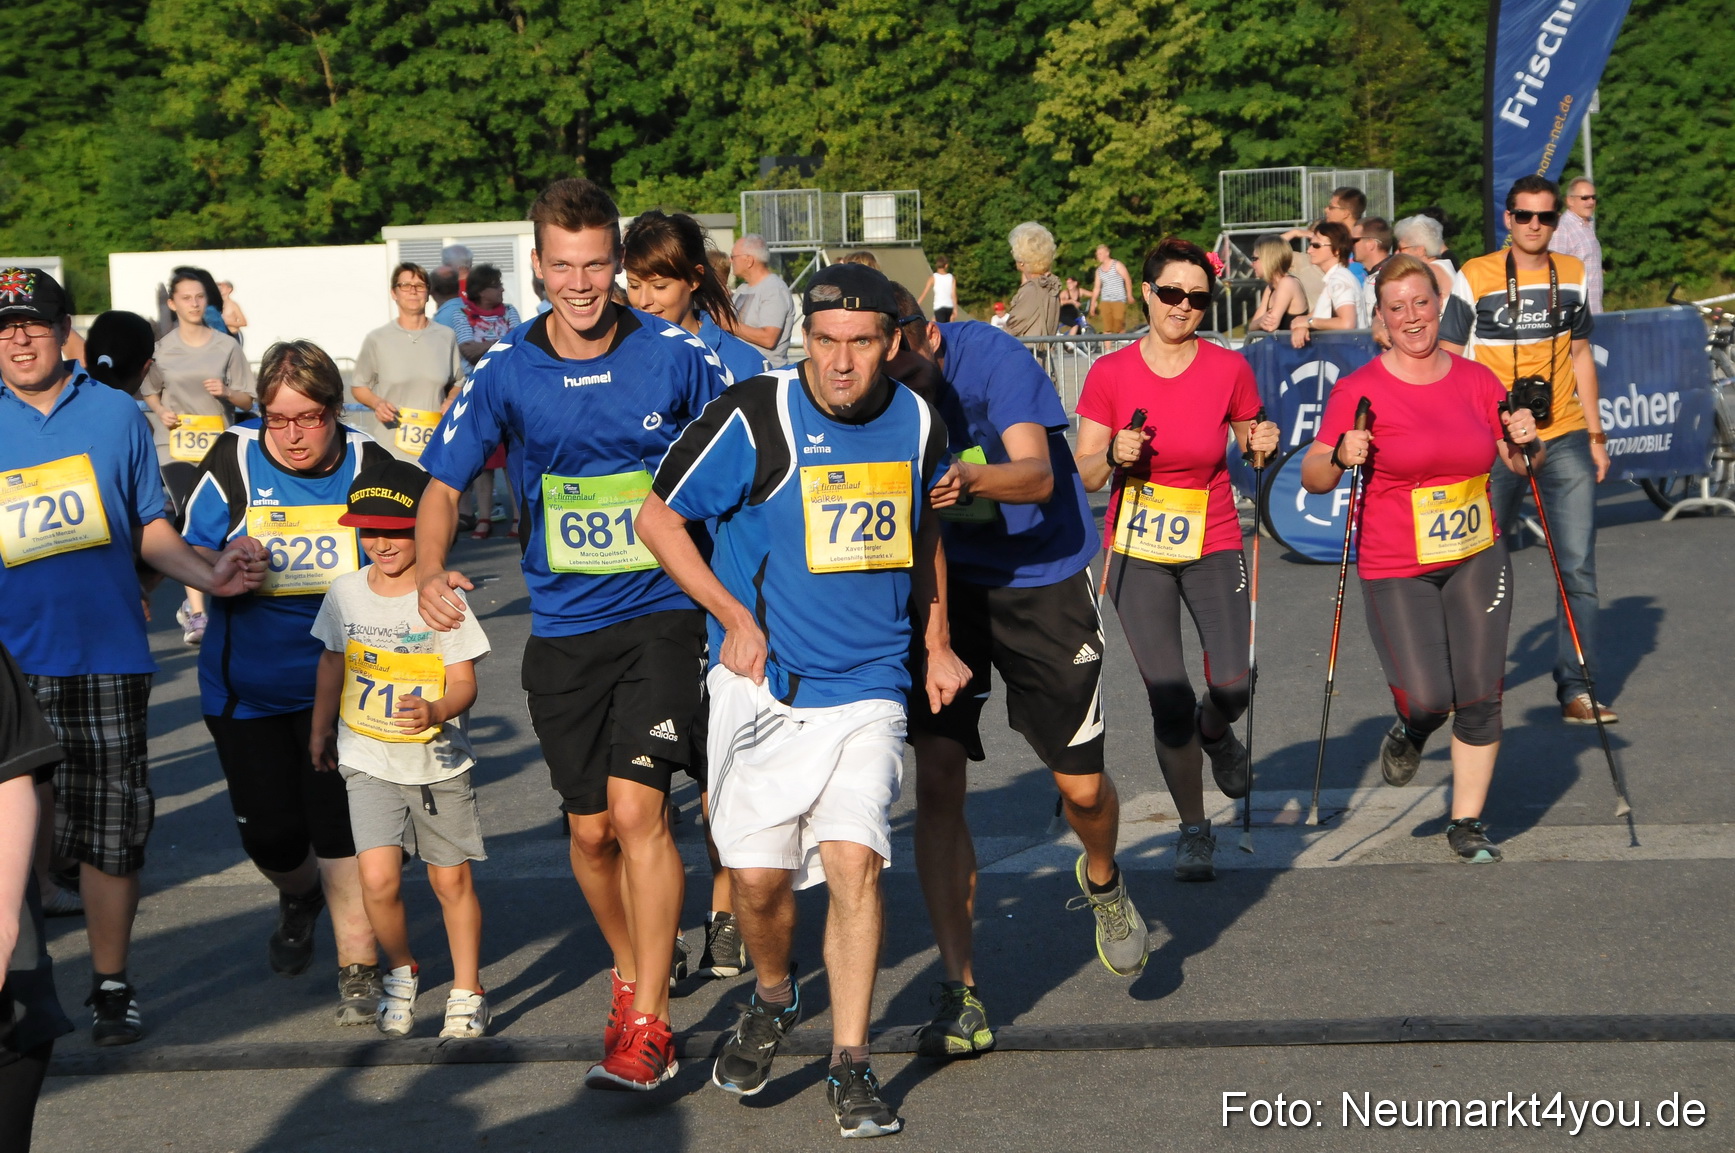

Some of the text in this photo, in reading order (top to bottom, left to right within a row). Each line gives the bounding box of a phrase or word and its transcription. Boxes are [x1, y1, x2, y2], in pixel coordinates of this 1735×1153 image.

[1515, 322, 1552, 330] AUTOMO
[563, 370, 612, 388] hummel
[1598, 382, 1680, 431] scher
[400, 424, 434, 445] 136
[803, 444, 832, 454] erima
[1606, 432, 1673, 457] TOMOBILE
[821, 480, 861, 491] firmenlauf
[252, 498, 280, 506] erima
[349, 486, 414, 508] DEUTSCHLAND
[557, 492, 596, 501] firmenlauf
[810, 494, 843, 504] walken
[5, 490, 85, 539] 720
[821, 500, 897, 544] 728
[1428, 503, 1482, 542] 420
[559, 508, 636, 550] 681
[1126, 508, 1190, 545] 419
[265, 535, 339, 573] 628
[599, 549, 628, 558] Queitsch
[1073, 652, 1100, 665] adidas
[649, 728, 679, 742] adidas
[631, 759, 655, 769] adidas
